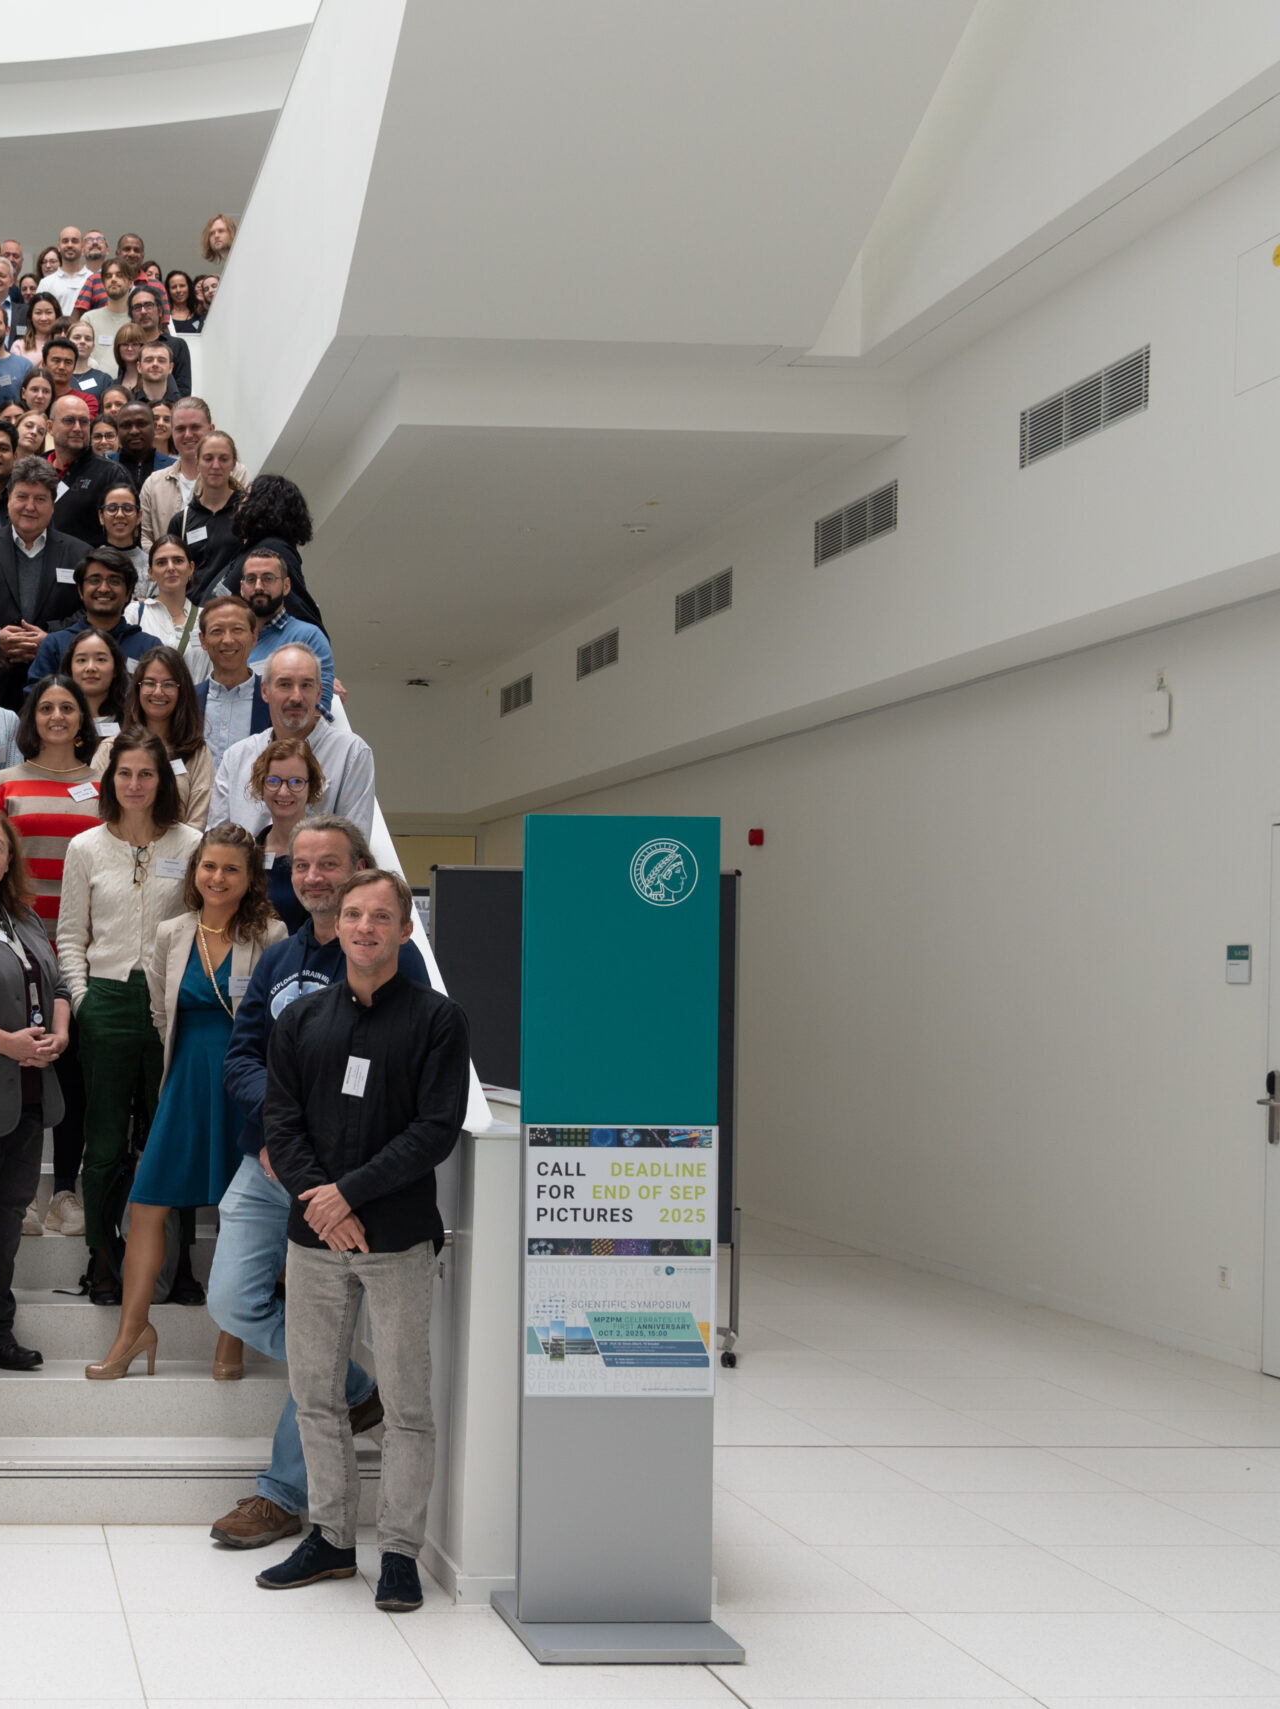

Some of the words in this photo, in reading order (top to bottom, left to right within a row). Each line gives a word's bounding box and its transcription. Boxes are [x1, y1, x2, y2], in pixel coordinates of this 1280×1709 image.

[536, 1162, 586, 1176] CALL
[610, 1162, 707, 1177] DEADLINE
[536, 1185, 575, 1199] FOR
[592, 1185, 631, 1200] END
[638, 1185, 663, 1200] OF
[669, 1185, 706, 1200] SEP
[536, 1207, 633, 1222] PICTURES
[659, 1208, 706, 1223] 2025
[528, 1265, 638, 1277] ANNIVERSARY
[527, 1277, 609, 1289] SEMINARS
[615, 1277, 666, 1289] PARTY
[571, 1300, 627, 1309] SCIENTIFIC
[630, 1300, 691, 1309] SYMPOSIUM
[616, 1330, 623, 1338] 2,
[625, 1330, 647, 1338] 2025,
[527, 1368, 608, 1380] SEMINARS
[614, 1368, 665, 1380] PARTY
[527, 1381, 597, 1393] VERSARY
